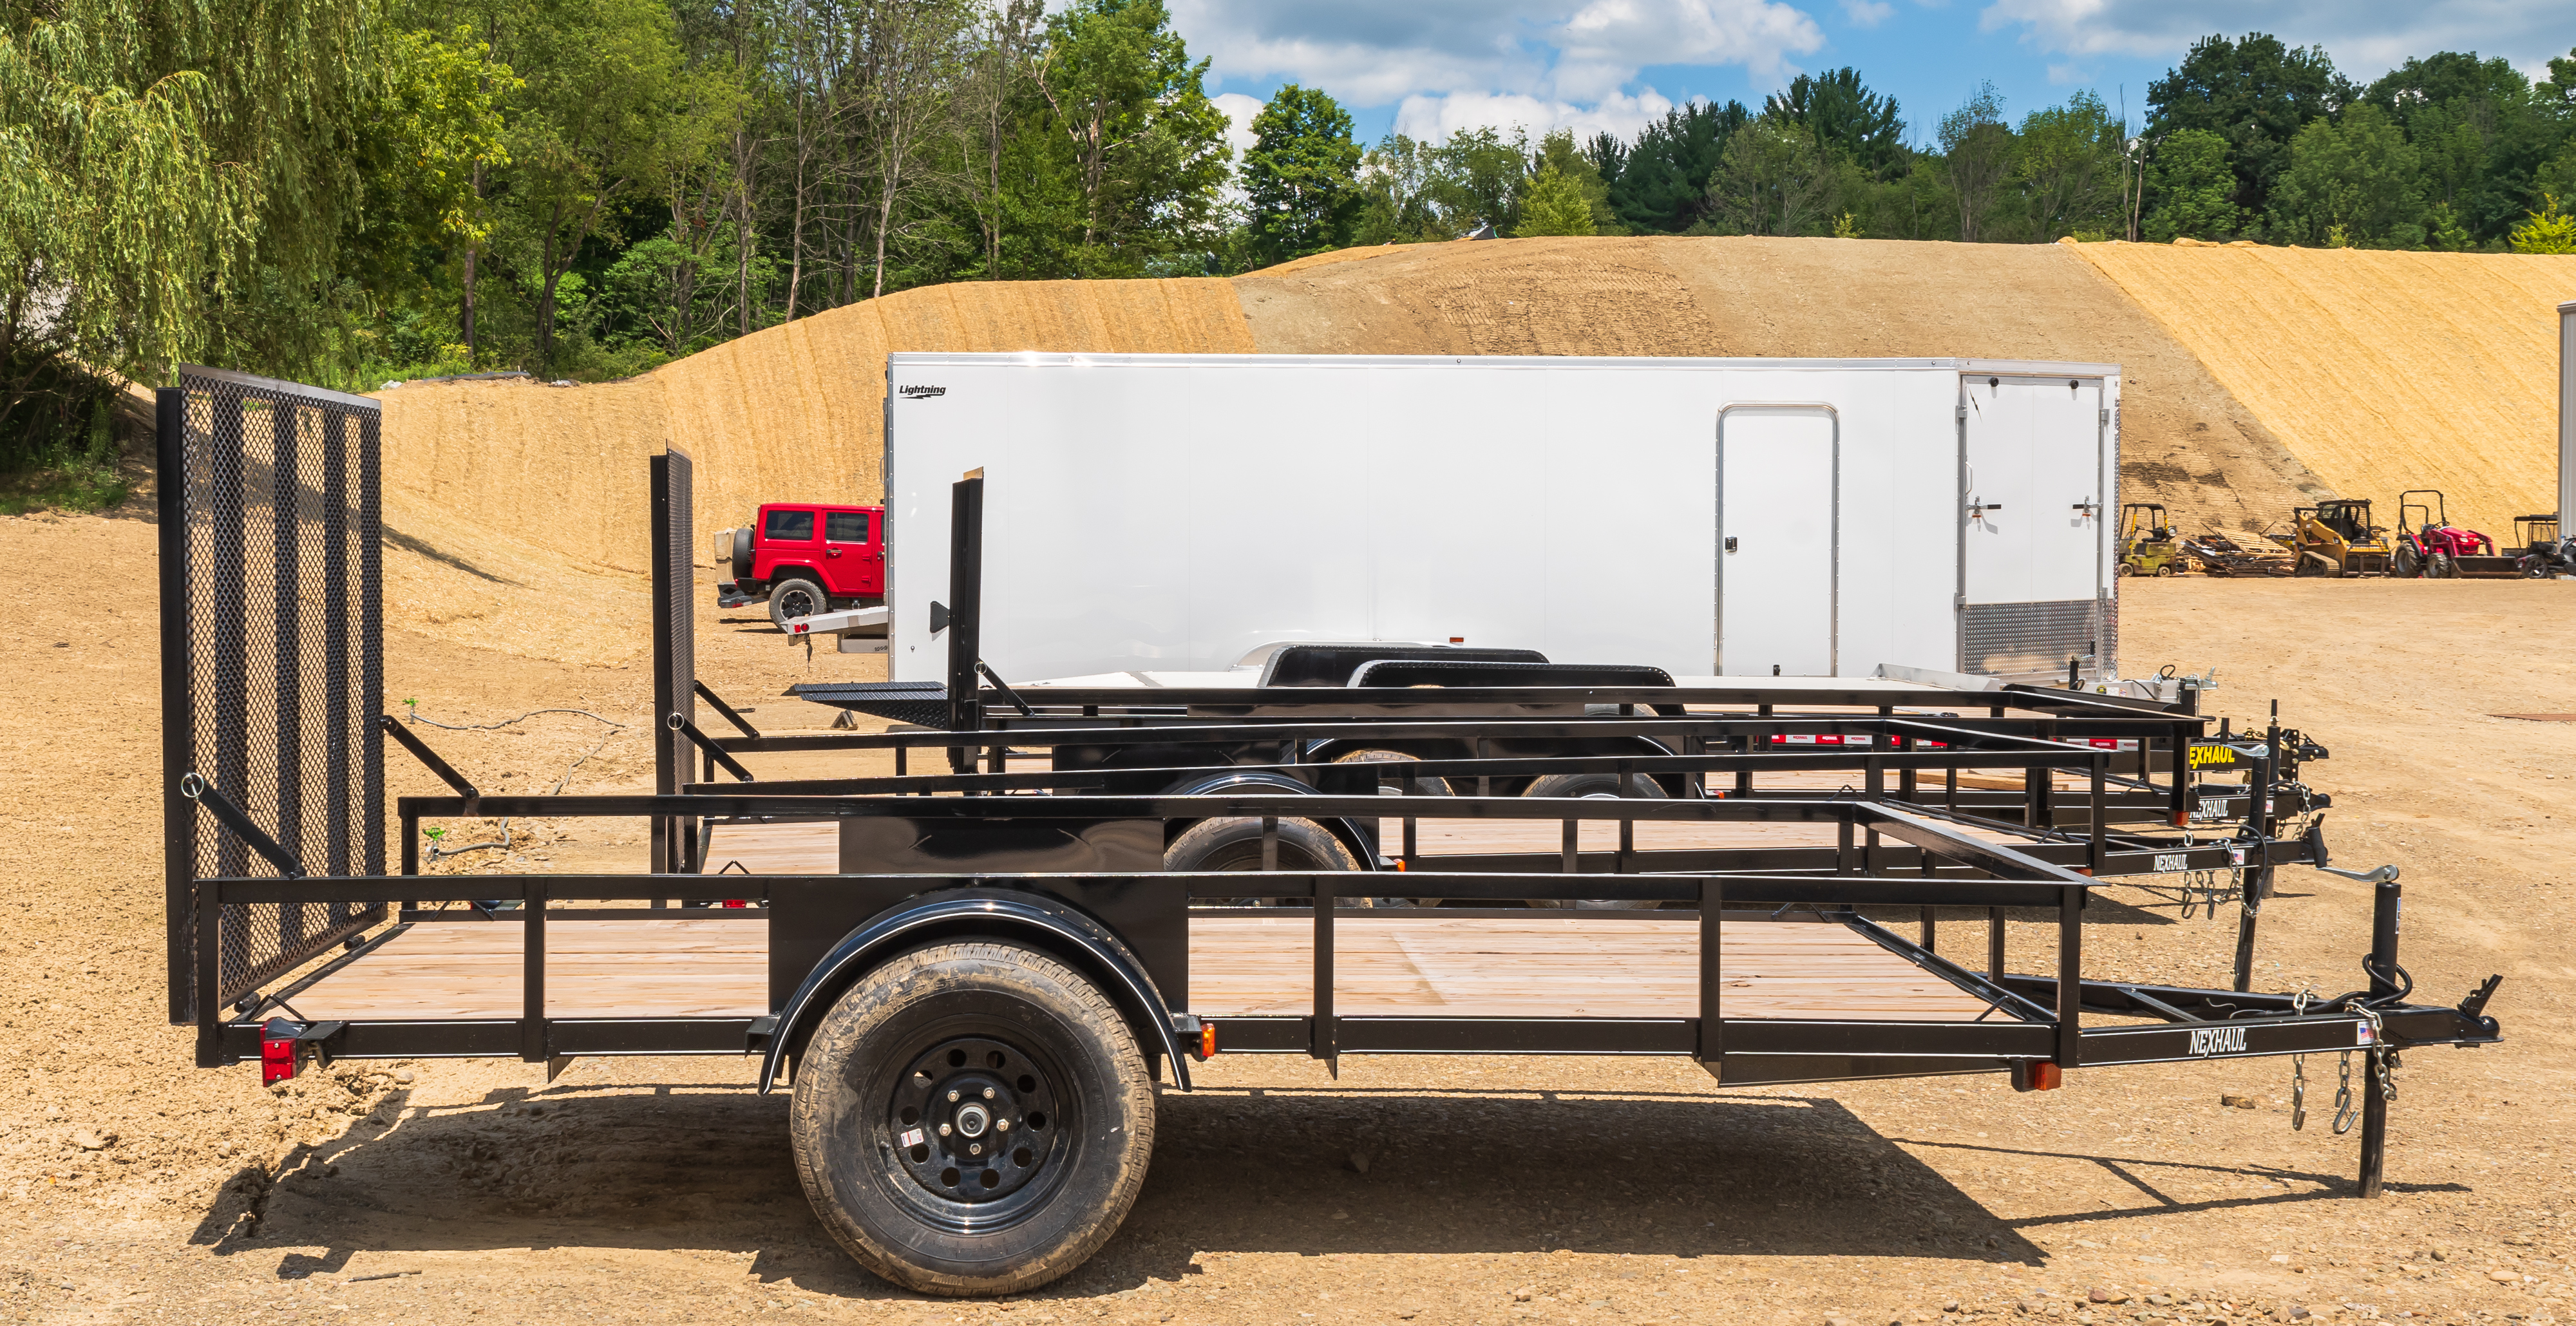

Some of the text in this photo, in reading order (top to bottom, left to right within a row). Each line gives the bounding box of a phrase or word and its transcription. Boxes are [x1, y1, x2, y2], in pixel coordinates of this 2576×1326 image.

[899, 385, 946, 396] Lightning
[2190, 746, 2235, 769] EXHAUL
[2153, 854, 2188, 873] NEXHAUL
[2188, 1028, 2246, 1057] NEXHAUL
